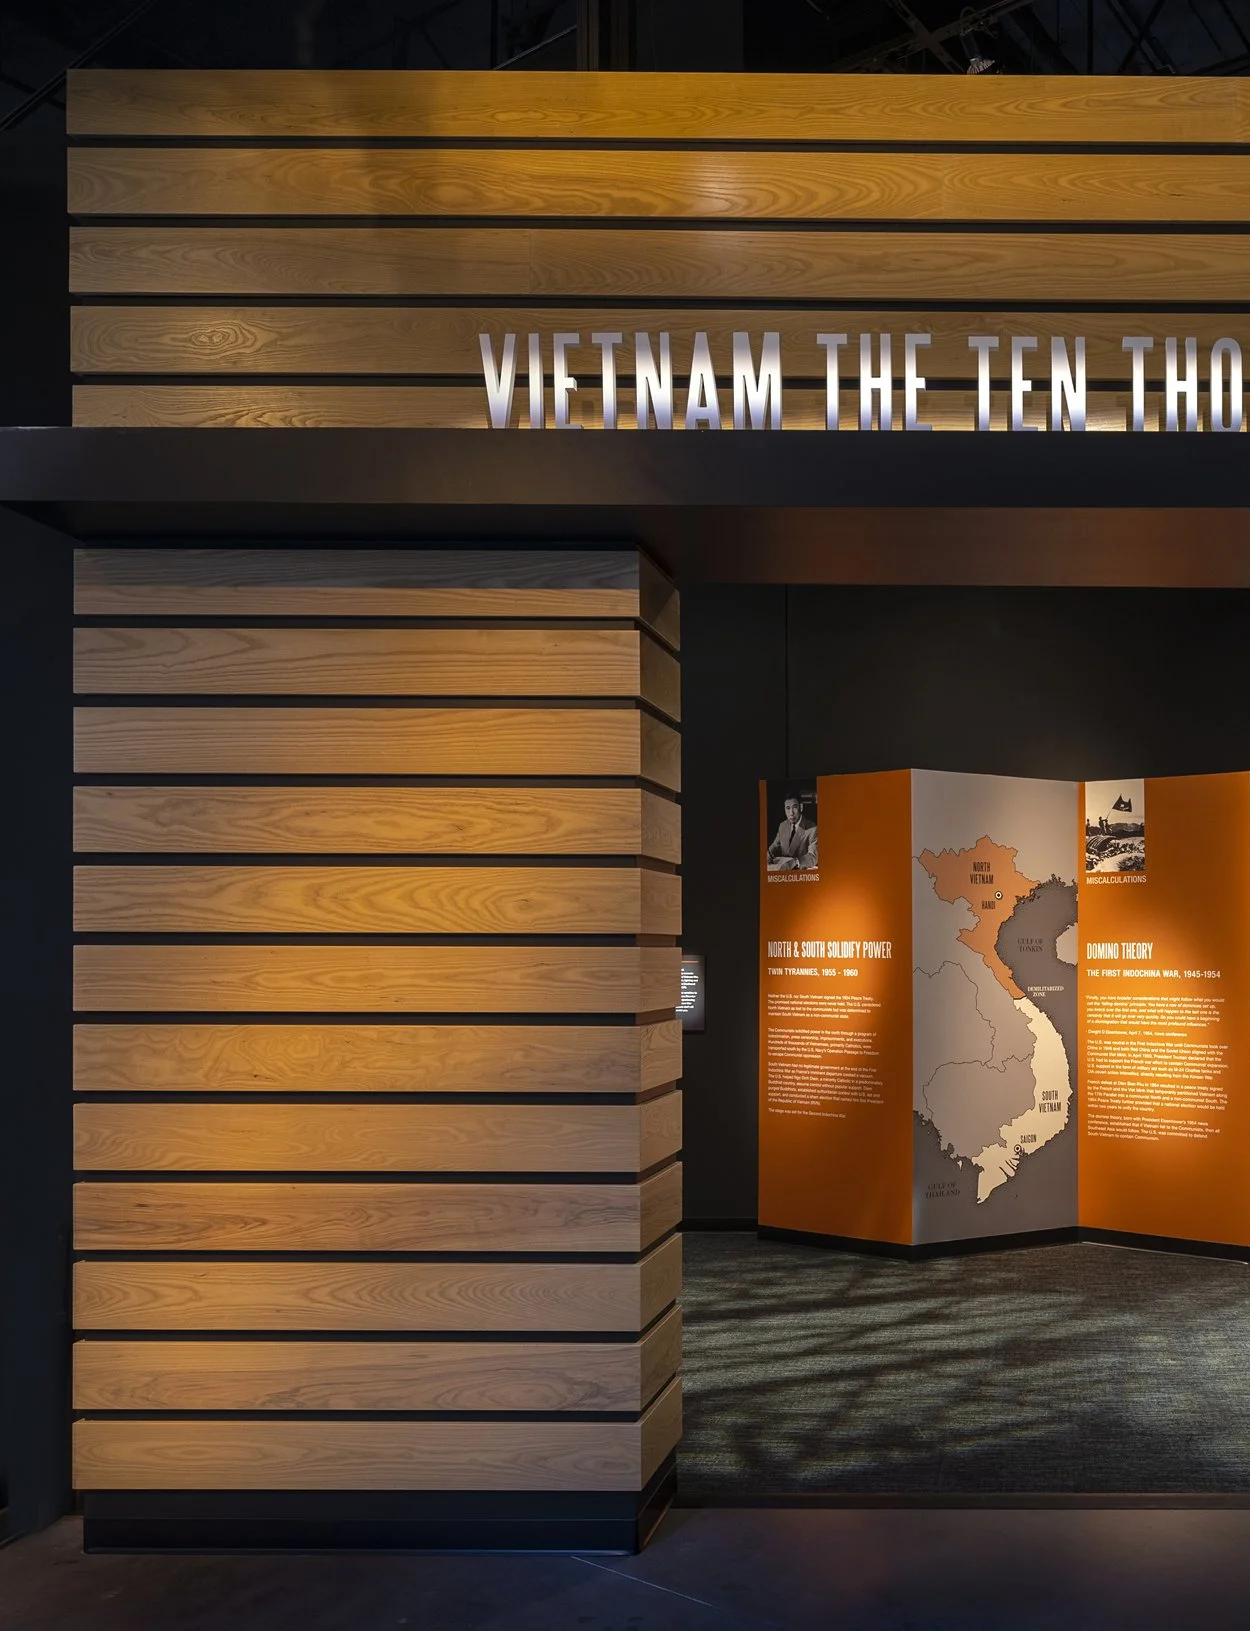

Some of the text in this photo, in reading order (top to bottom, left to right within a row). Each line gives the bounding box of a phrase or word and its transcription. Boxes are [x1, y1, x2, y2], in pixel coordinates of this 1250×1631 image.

[479, 331, 783, 430] VIETNAM
[817, 333, 932, 431] THE
[968, 336, 1087, 431] TEN
[972, 861, 991, 873] NORTH
[767, 874, 820, 883] MISCALCULATIONS
[970, 873, 994, 885] VIETNAM
[1086, 875, 1147, 885] MISCALCULATIONS
[981, 900, 996, 910] HANOI
[767, 941, 892, 959] NORTH & SOUTH SOLIDIFY POWER
[1019, 945, 1043, 953] TONKIN
[1086, 943, 1154, 960] DOMINO THEORY
[767, 968, 783, 976] TWIN
[785, 968, 820, 977] TYRANNIES,
[822, 969, 837, 977] 1955
[843, 969, 858, 977] 1960
[1086, 969, 1221, 979] THE FIRST INDOCHINA WAR, 1945-1954
[1027, 985, 1065, 993] DEMILITARIZED
[1042, 1090, 1059, 1101] SOUTH
[1038, 1101, 1062, 1113] VIETNAM
[1020, 1134, 1037, 1144] SAIGON
